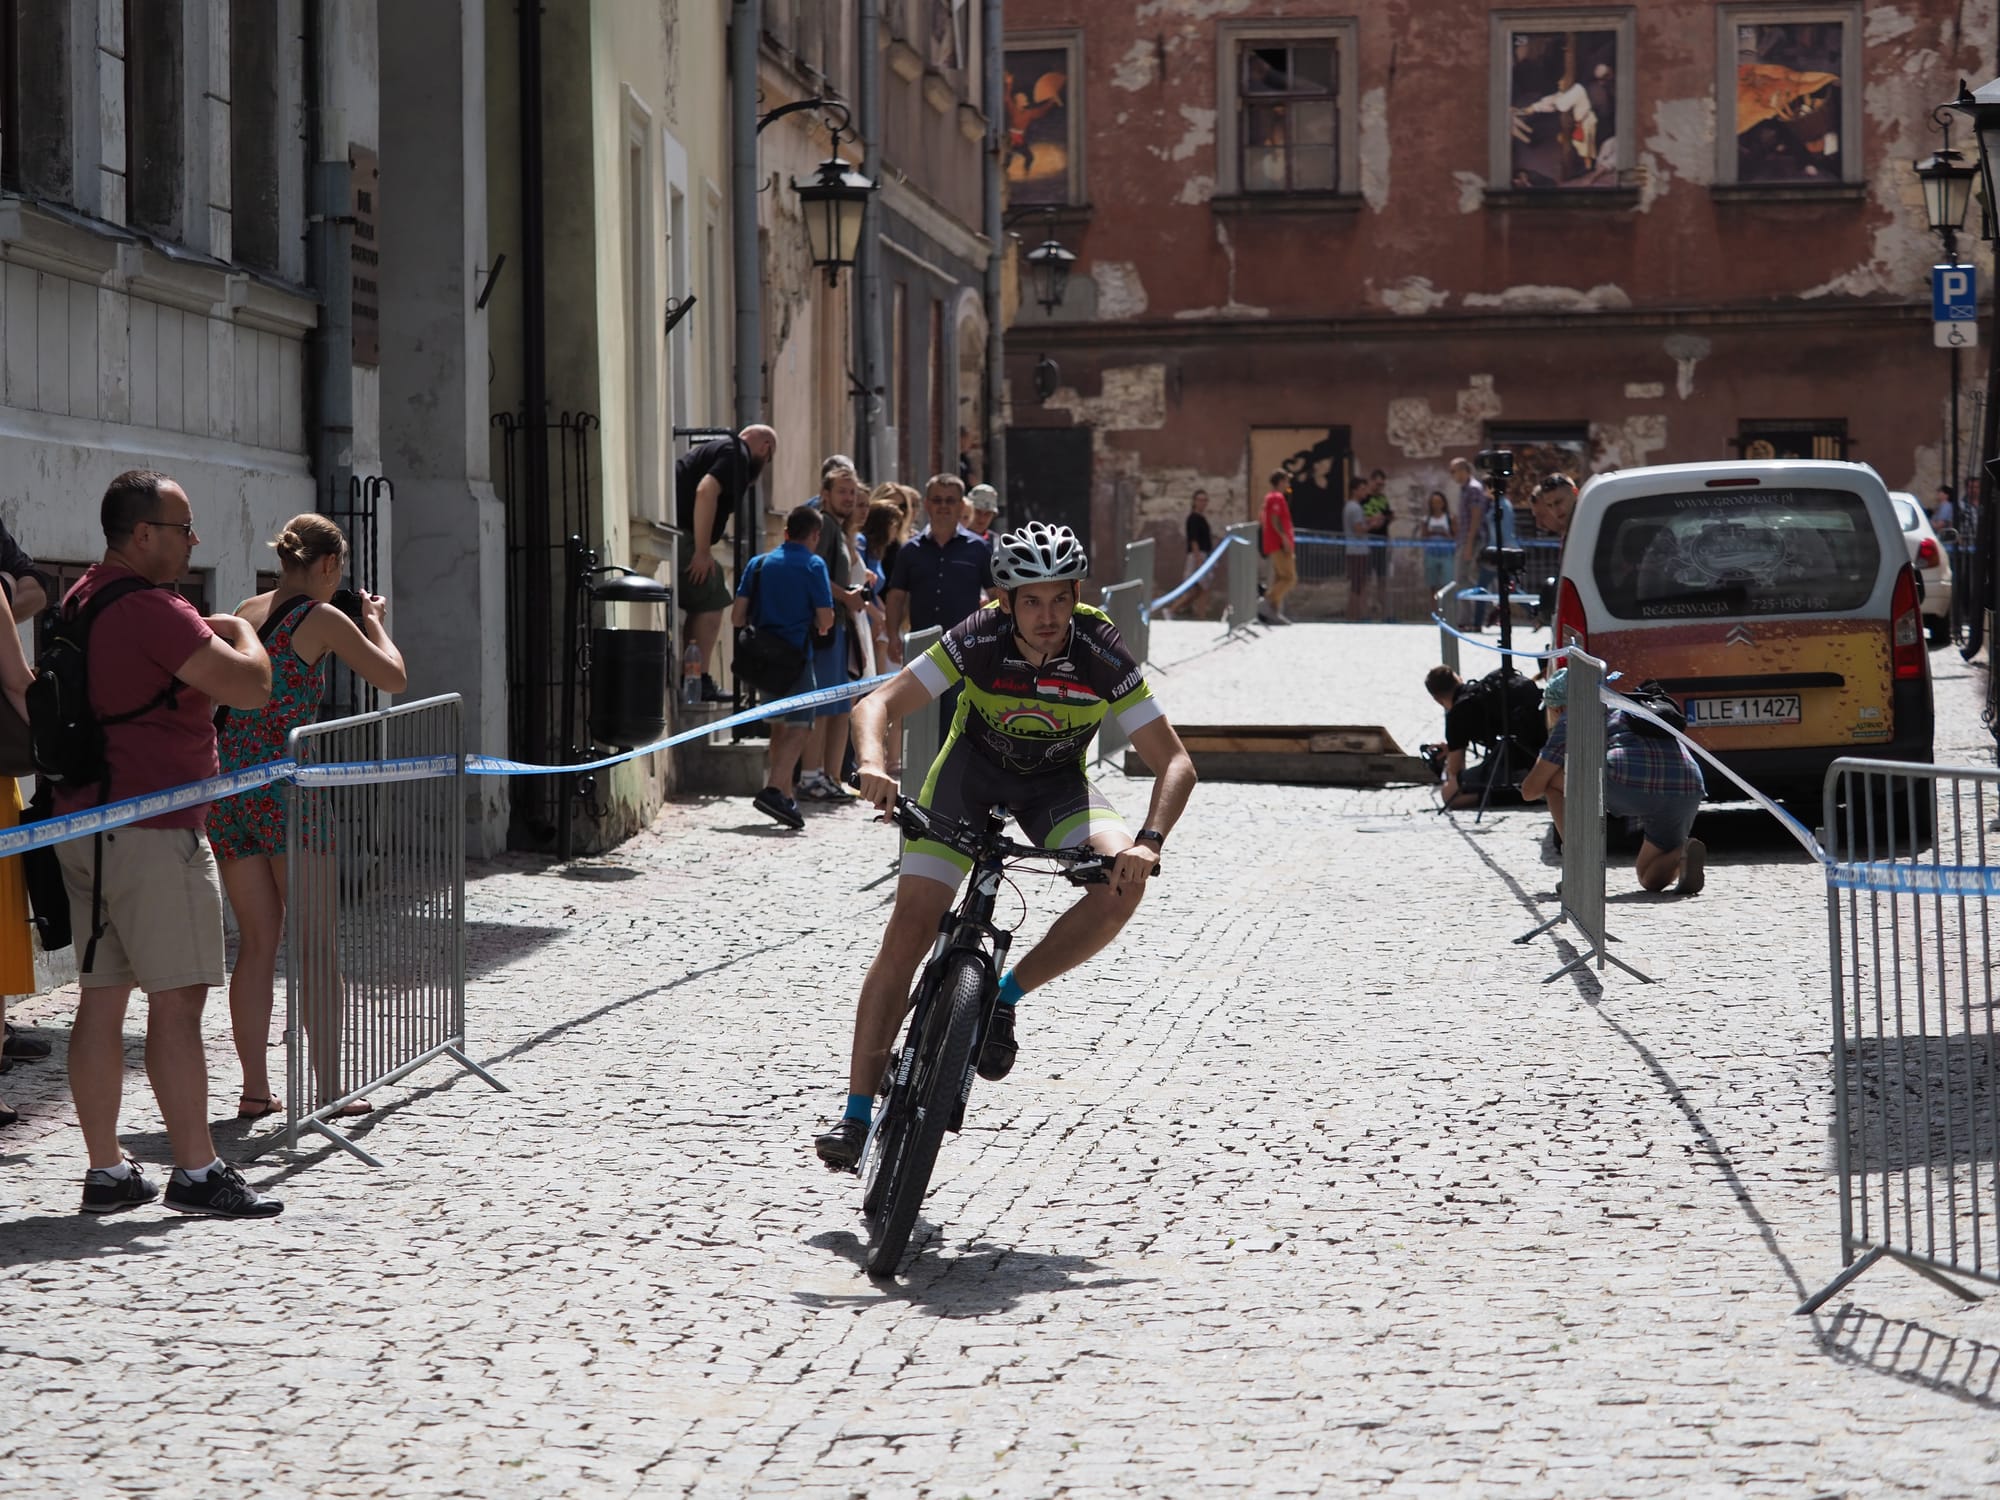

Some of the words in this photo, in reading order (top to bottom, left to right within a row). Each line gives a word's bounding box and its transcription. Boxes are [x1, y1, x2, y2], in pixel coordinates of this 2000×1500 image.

[1942, 272, 1968, 306] P
[1696, 701, 1734, 720] LLE
[1741, 698, 1796, 718] 11427
[896, 1047, 915, 1087] ROCKSHOX
